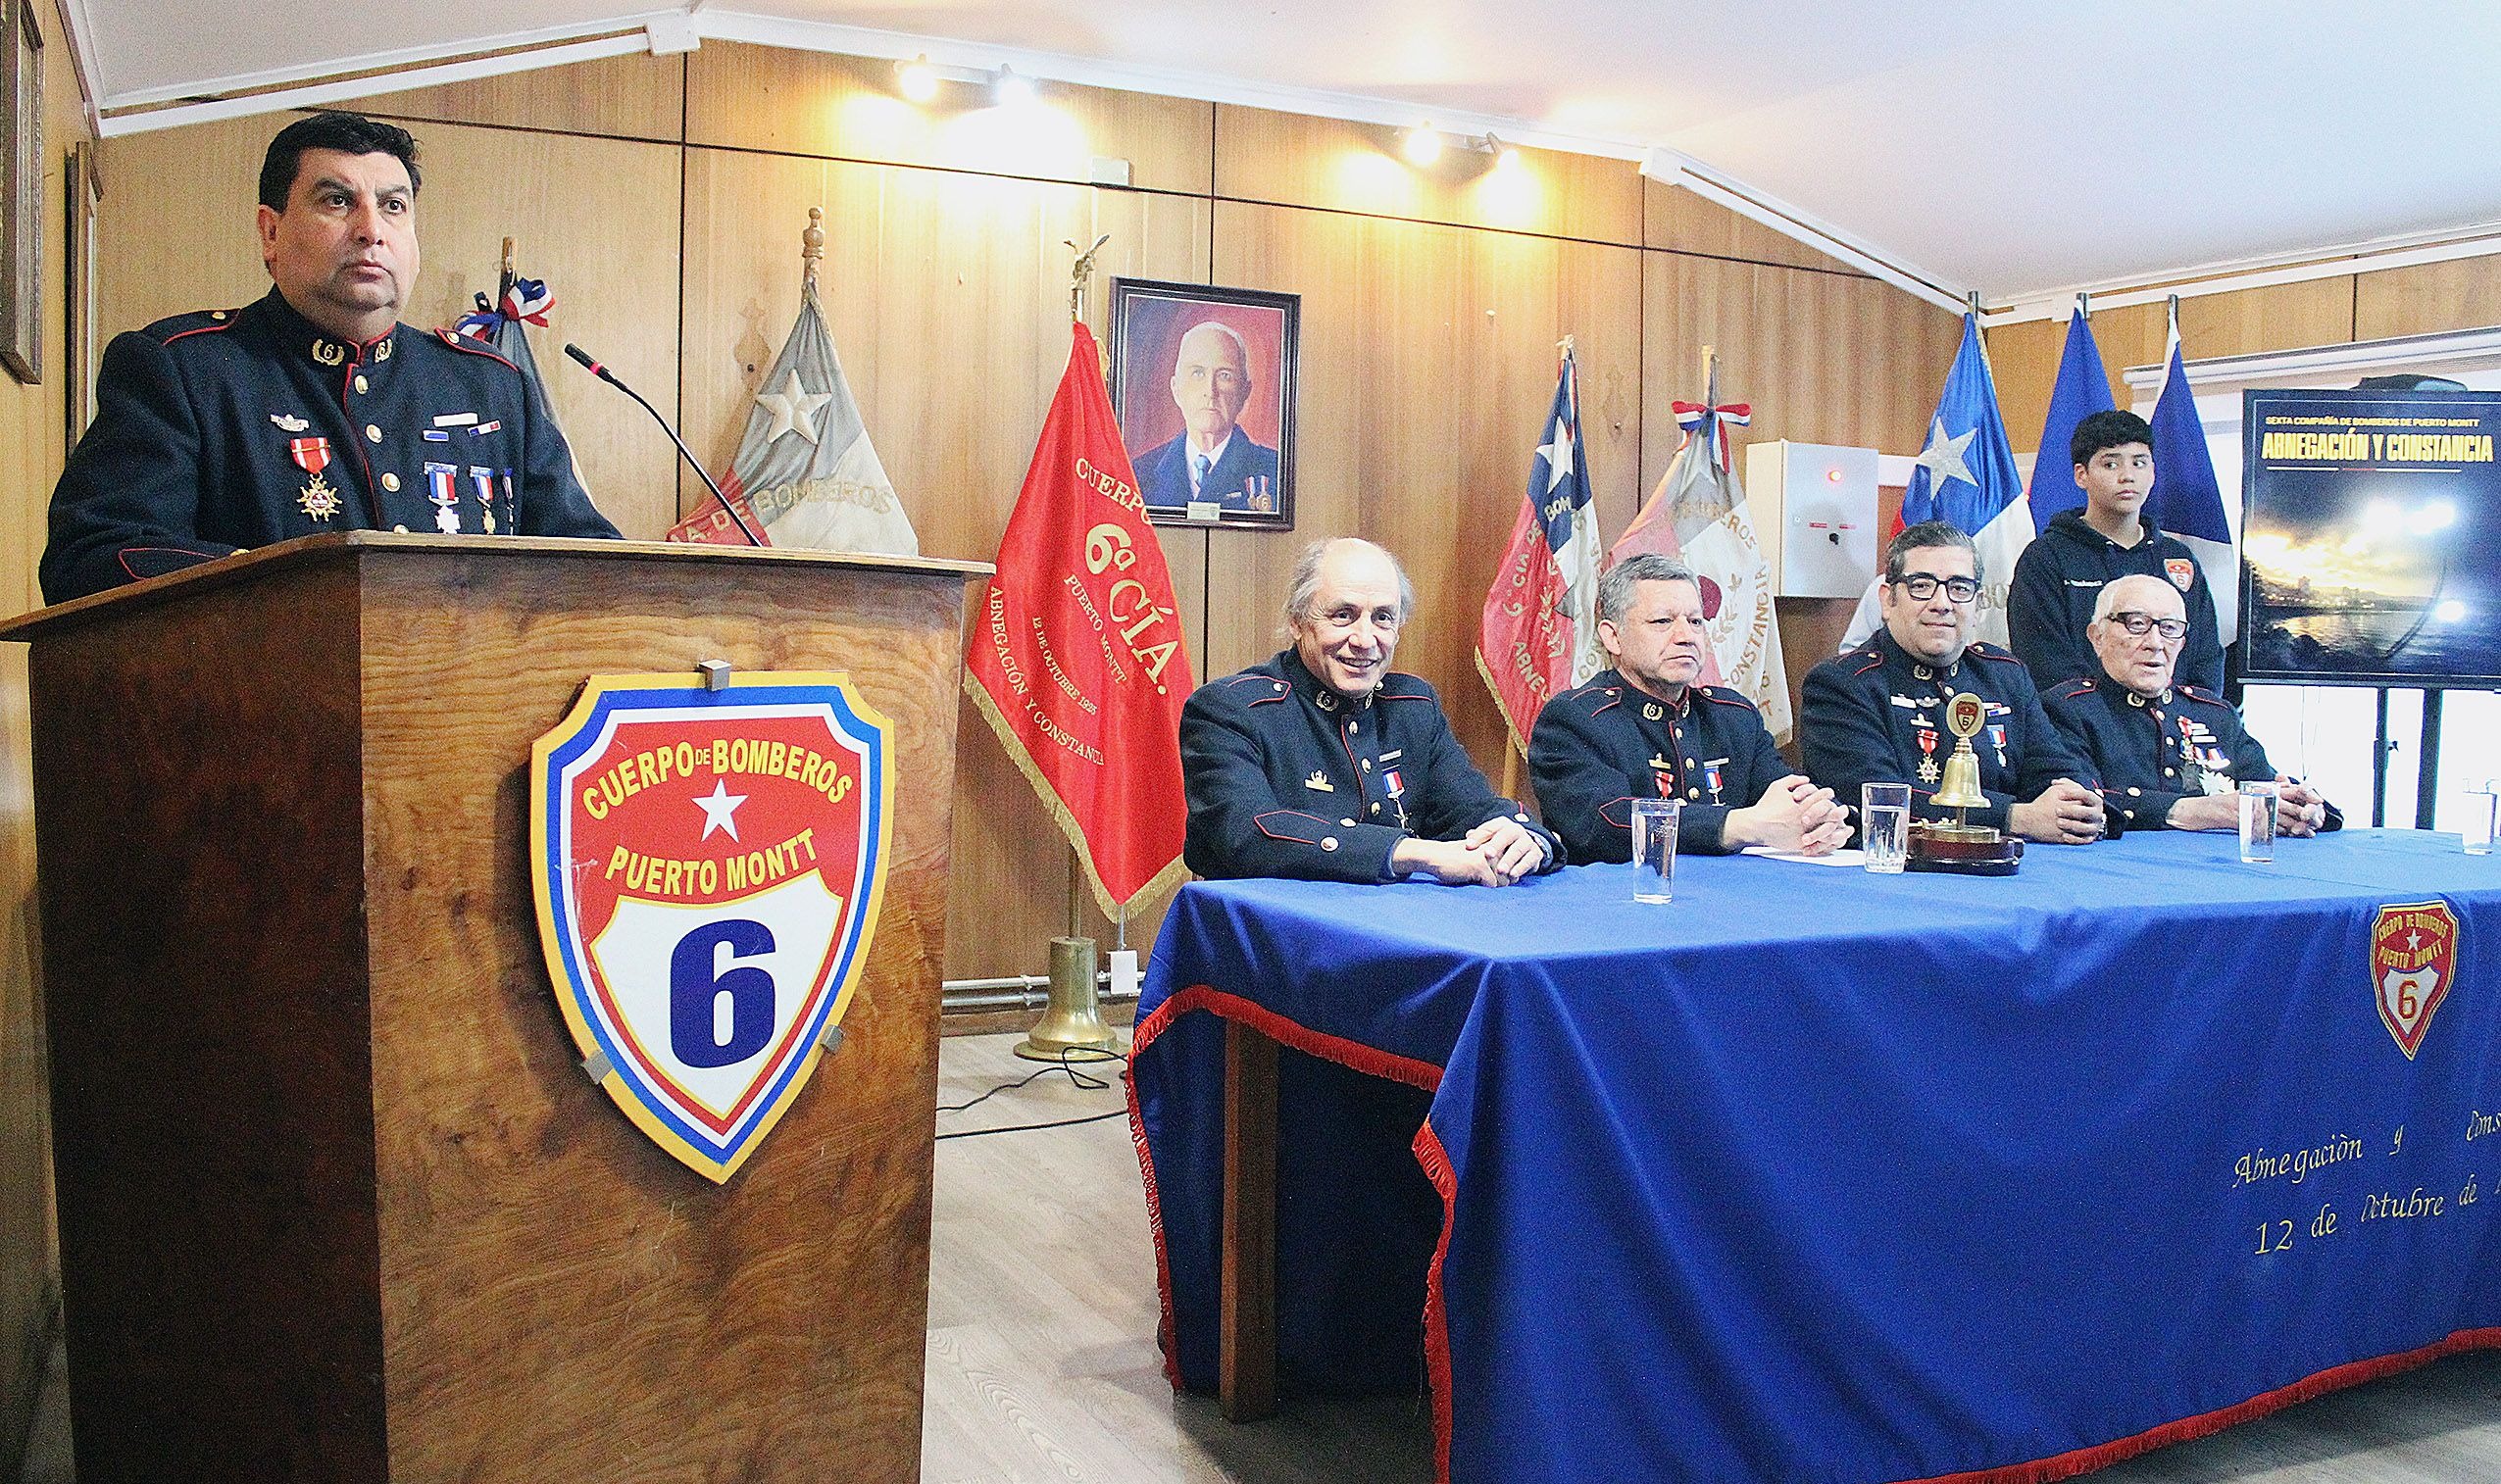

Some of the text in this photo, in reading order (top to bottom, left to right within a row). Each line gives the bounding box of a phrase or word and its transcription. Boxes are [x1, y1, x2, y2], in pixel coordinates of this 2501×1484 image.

[324, 343, 334, 359] 6
[2266, 417, 2293, 425] SEXTA
[2340, 418, 2353, 426] DE
[2353, 417, 2400, 427] BOMBEROS
[2413, 418, 2447, 427] PUERTO
[2448, 419, 2480, 427] MONTT
[2262, 427, 2494, 463] ABNEGACIÓN Y CONSTANCIA
[710, 496, 751, 532] DE
[754, 478, 894, 515] BOMBEROS
[1032, 617, 1043, 630] 12
[1035, 630, 1048, 649] DE
[1064, 573, 1127, 684] PUERTO MONTT
[990, 585, 1105, 767] ABNEGACIÓN Y CONSTANCIA
[1042, 648, 1080, 701] OCTUBRE
[1648, 704, 1657, 717] 6
[581, 738, 854, 821] CUERPO DE BOMBEROS
[605, 827, 820, 896] PUERTO MONTT
[2378, 915, 2403, 942] CUERPO
[2415, 913, 2449, 939] BOMBEROS
[2377, 939, 2443, 969] PUERTO MONTT
[670, 918, 776, 1069] 6
[2397, 978, 2420, 1021] 6
[2254, 1219, 2294, 1256] 12
[2311, 1202, 2338, 1238] de
[2459, 1174, 2478, 1207] de
